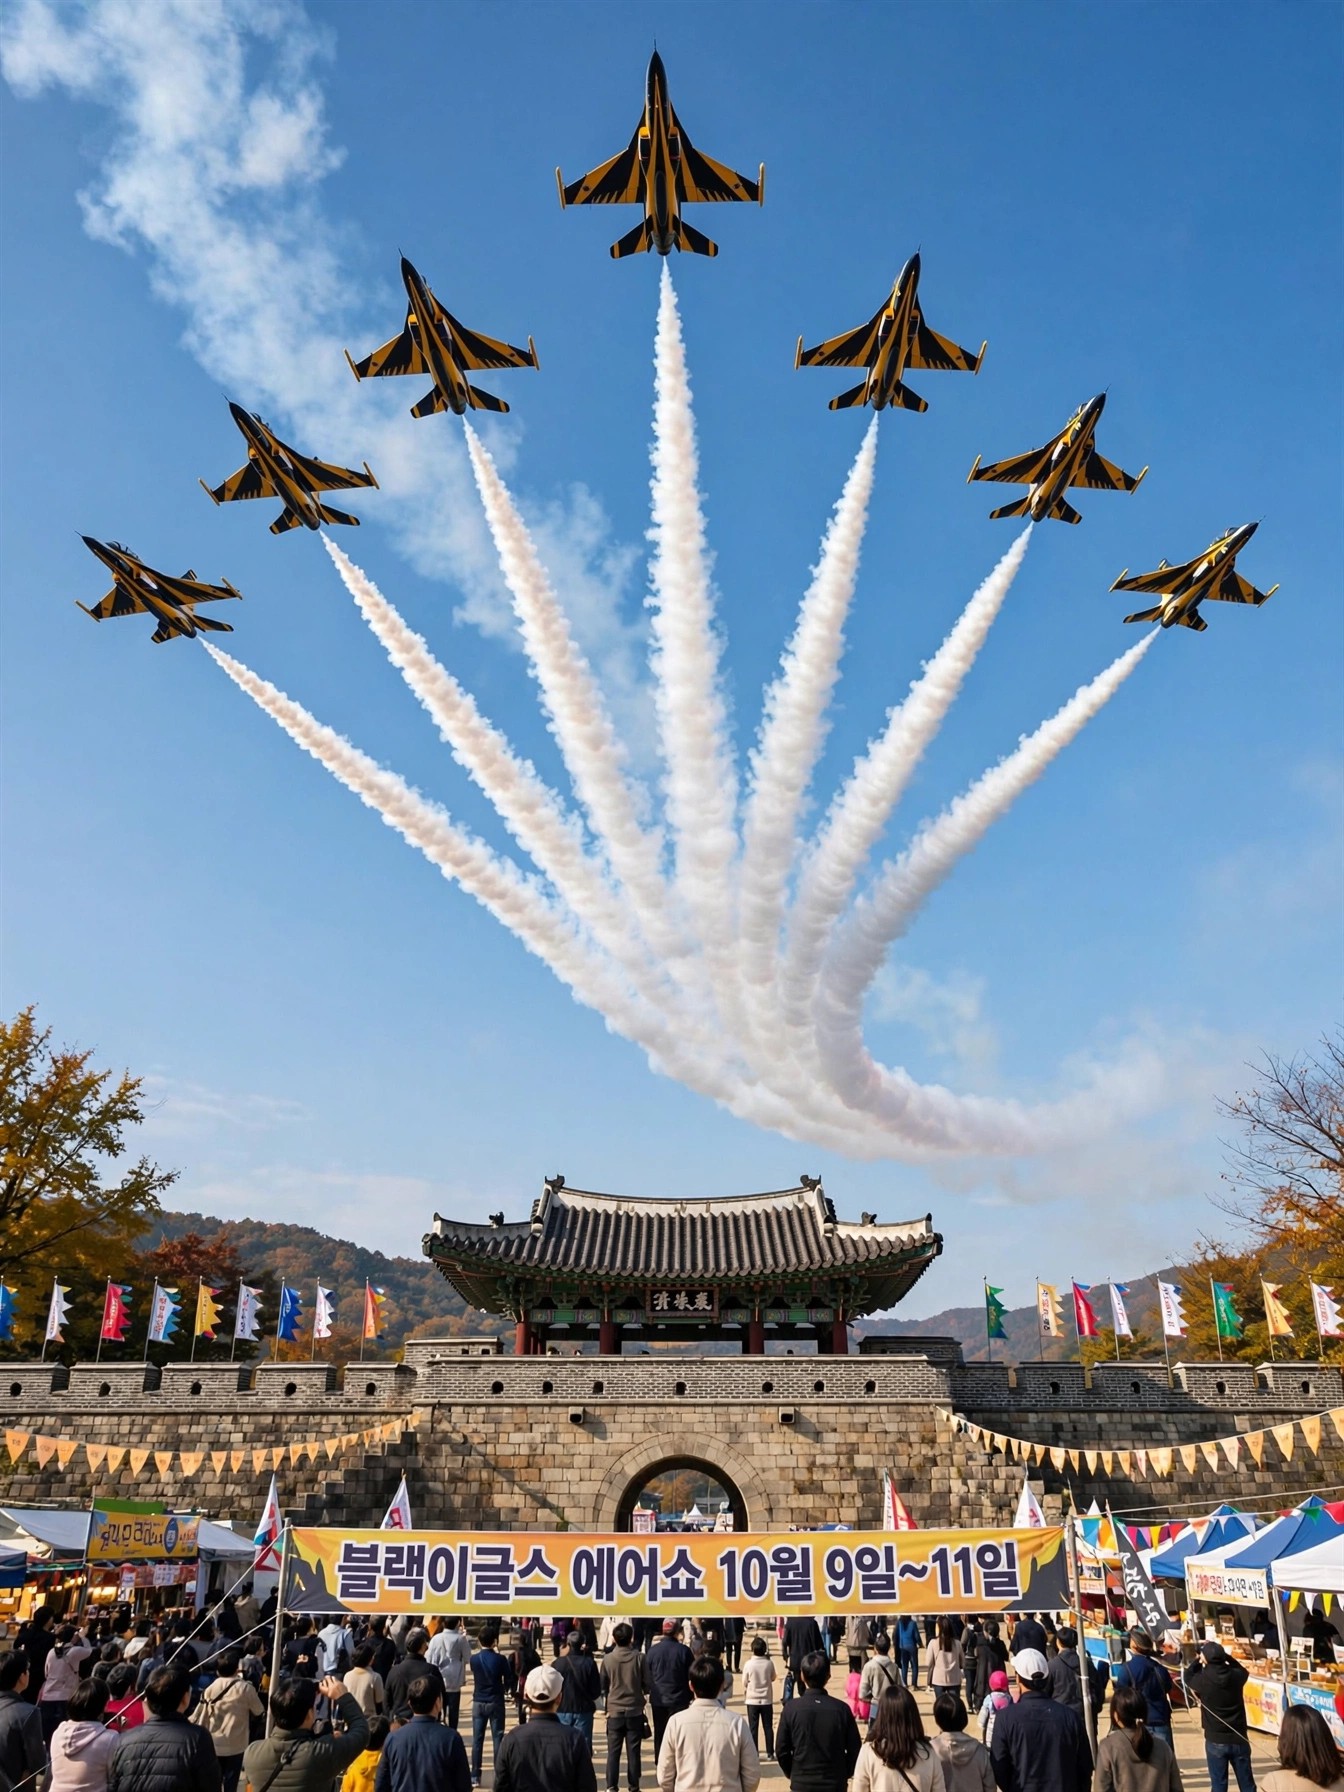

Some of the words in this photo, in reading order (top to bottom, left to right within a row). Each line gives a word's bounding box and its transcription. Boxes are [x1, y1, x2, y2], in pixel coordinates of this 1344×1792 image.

[336, 1541, 559, 1602] 블랙이글스
[571, 1545, 705, 1602] 에어쇼
[718, 1546, 813, 1603] 10월
[824, 1541, 1021, 1602] 9일~11일
